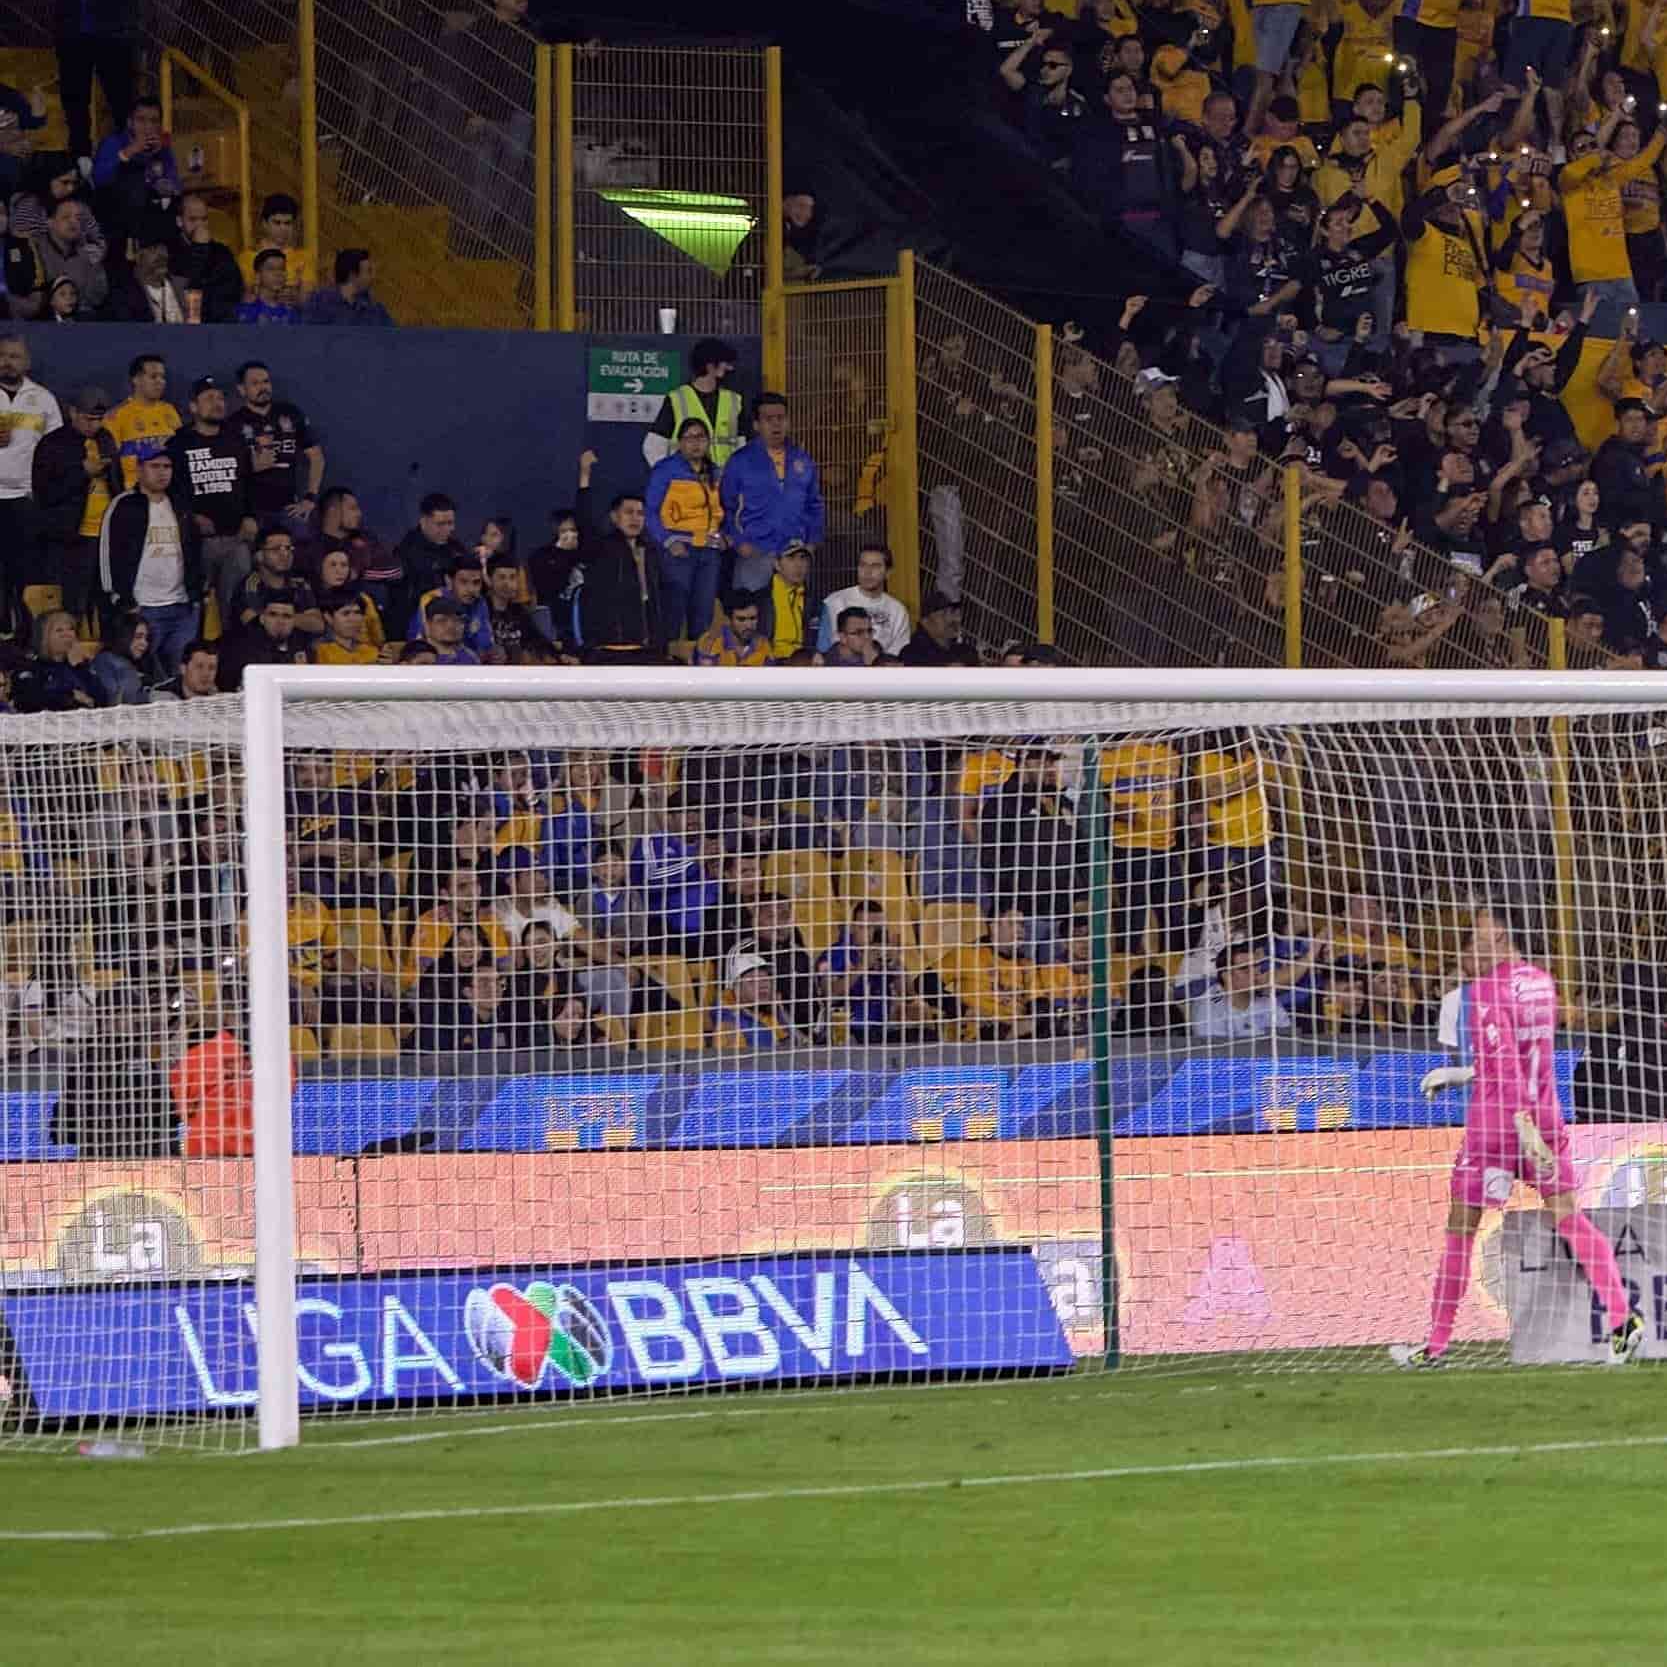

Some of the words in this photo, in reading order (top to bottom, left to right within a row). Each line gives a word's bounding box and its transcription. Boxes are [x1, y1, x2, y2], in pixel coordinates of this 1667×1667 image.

[611, 351, 640, 363] RUTA
[643, 351, 658, 364] DE
[187, 447, 212, 461] THE
[189, 457, 238, 473] FAMOUS
[190, 469, 239, 484] DOUBLE
[897, 1195, 965, 1248] La
[95, 1202, 164, 1274] La
[606, 1261, 929, 1380] BBVA
